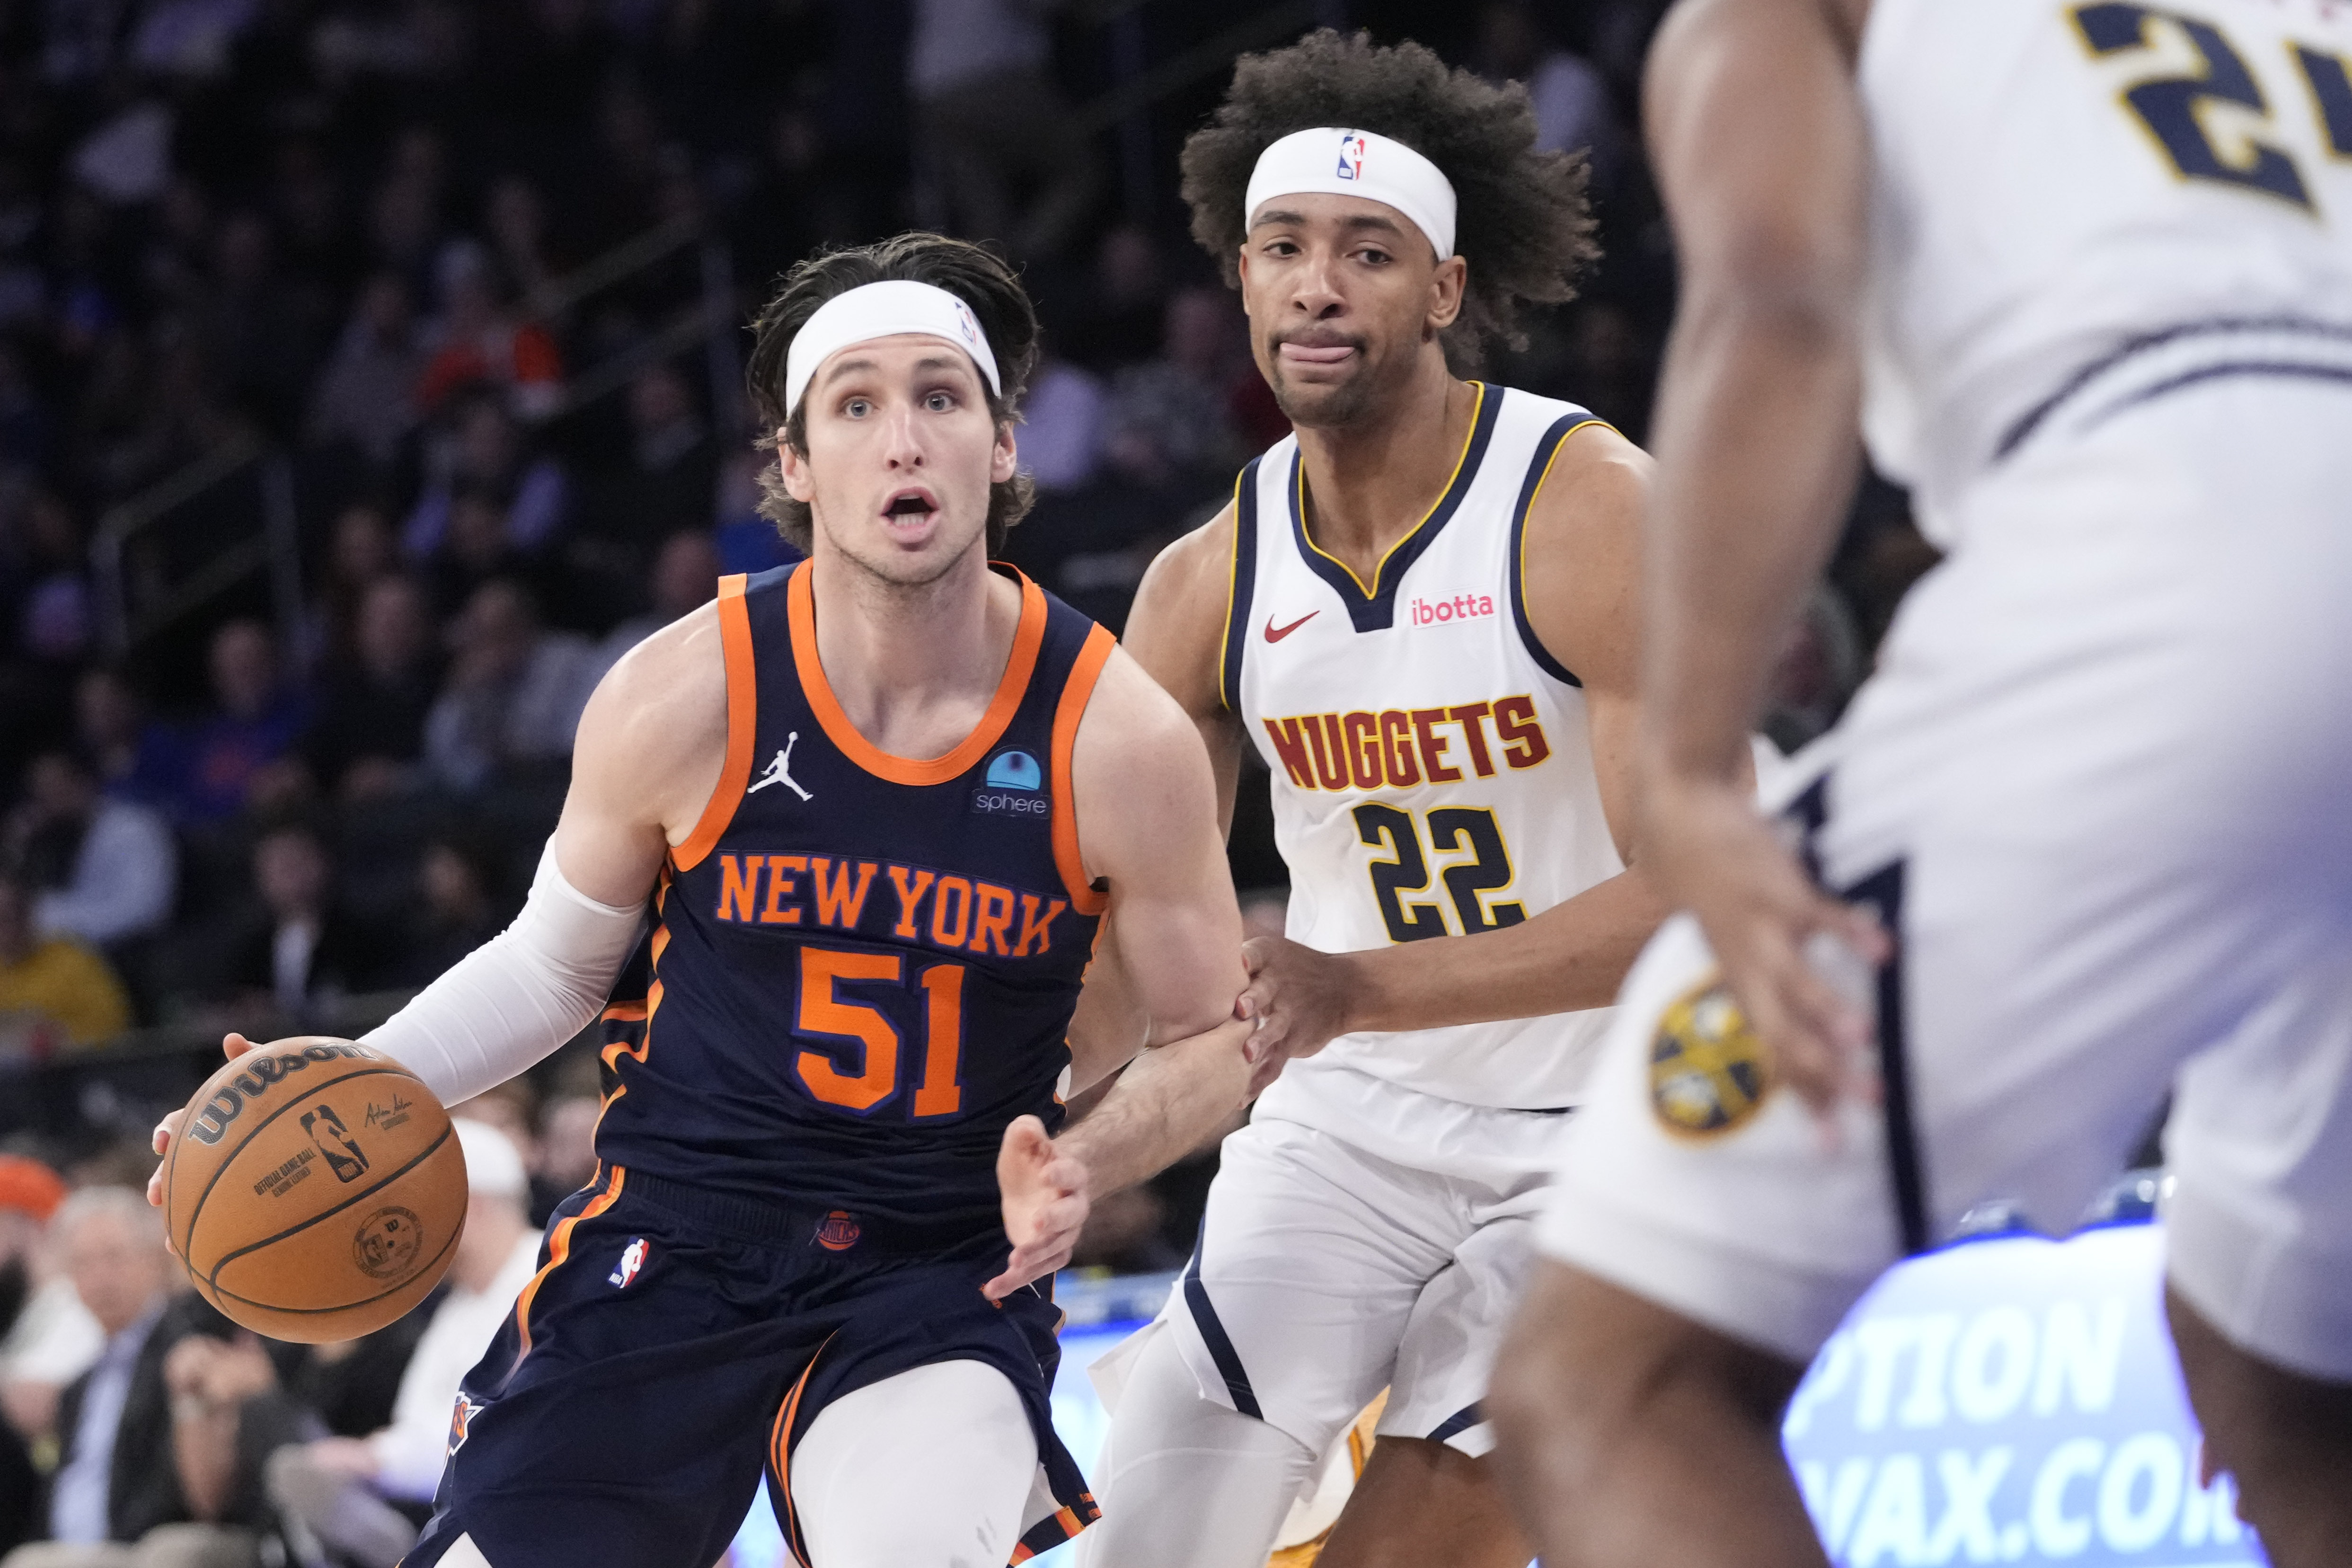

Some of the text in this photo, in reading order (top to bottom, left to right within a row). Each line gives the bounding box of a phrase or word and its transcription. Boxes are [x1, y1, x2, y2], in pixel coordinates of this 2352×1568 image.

[2063, 2, 2352, 214] 2
[1412, 594, 1494, 625] ibotta
[1263, 693, 1553, 792] NUGGETS
[976, 793, 1047, 814] sphere
[716, 854, 1068, 958] NEW YORK
[1352, 800, 1530, 944] 22
[793, 945, 967, 1120] 51
[188, 1043, 380, 1145] Wilson
[254, 1147, 317, 1196] OFFICIAL GAME BALL
